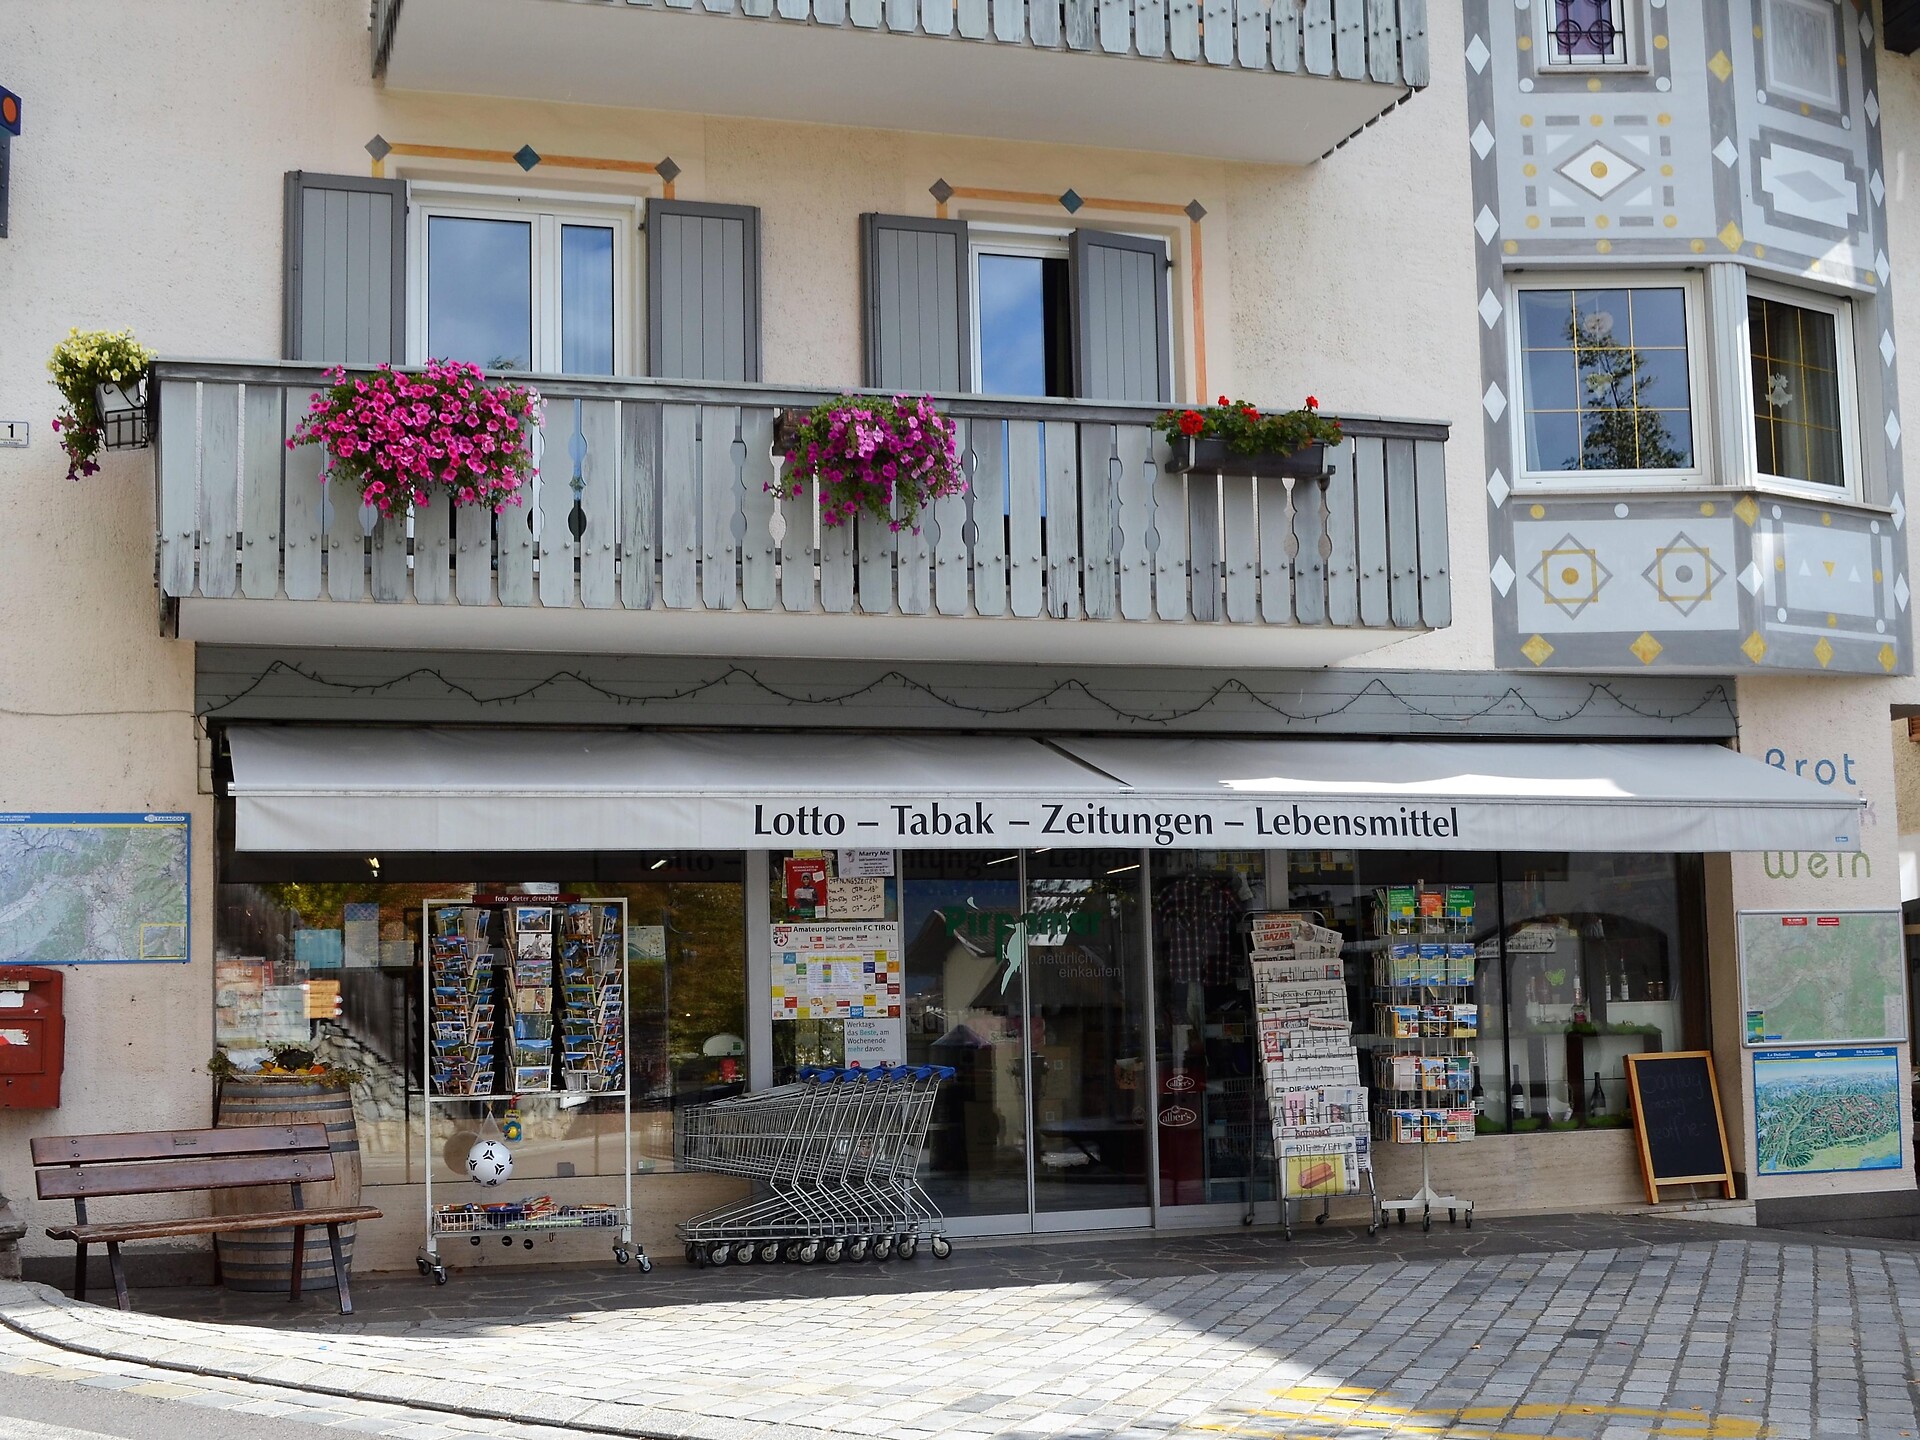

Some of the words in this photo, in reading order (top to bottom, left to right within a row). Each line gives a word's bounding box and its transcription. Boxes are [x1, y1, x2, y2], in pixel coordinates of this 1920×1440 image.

[8, 423, 14, 438] 1
[754, 804, 846, 836] Lotto
[890, 802, 995, 836] Tabak
[1041, 803, 1213, 846] Zeitungen
[1255, 804, 1459, 838] Lebensmittel
[944, 906, 1103, 964] Pirpamer
[1263, 931, 1291, 941] BAZAR
[1058, 965, 1121, 978] einkaufen
[846, 1022, 876, 1030] Werktags
[1162, 1112, 1192, 1122] alber's
[1296, 1144, 1311, 1152] DIE
[1322, 1142, 1341, 1151] ZEIT
